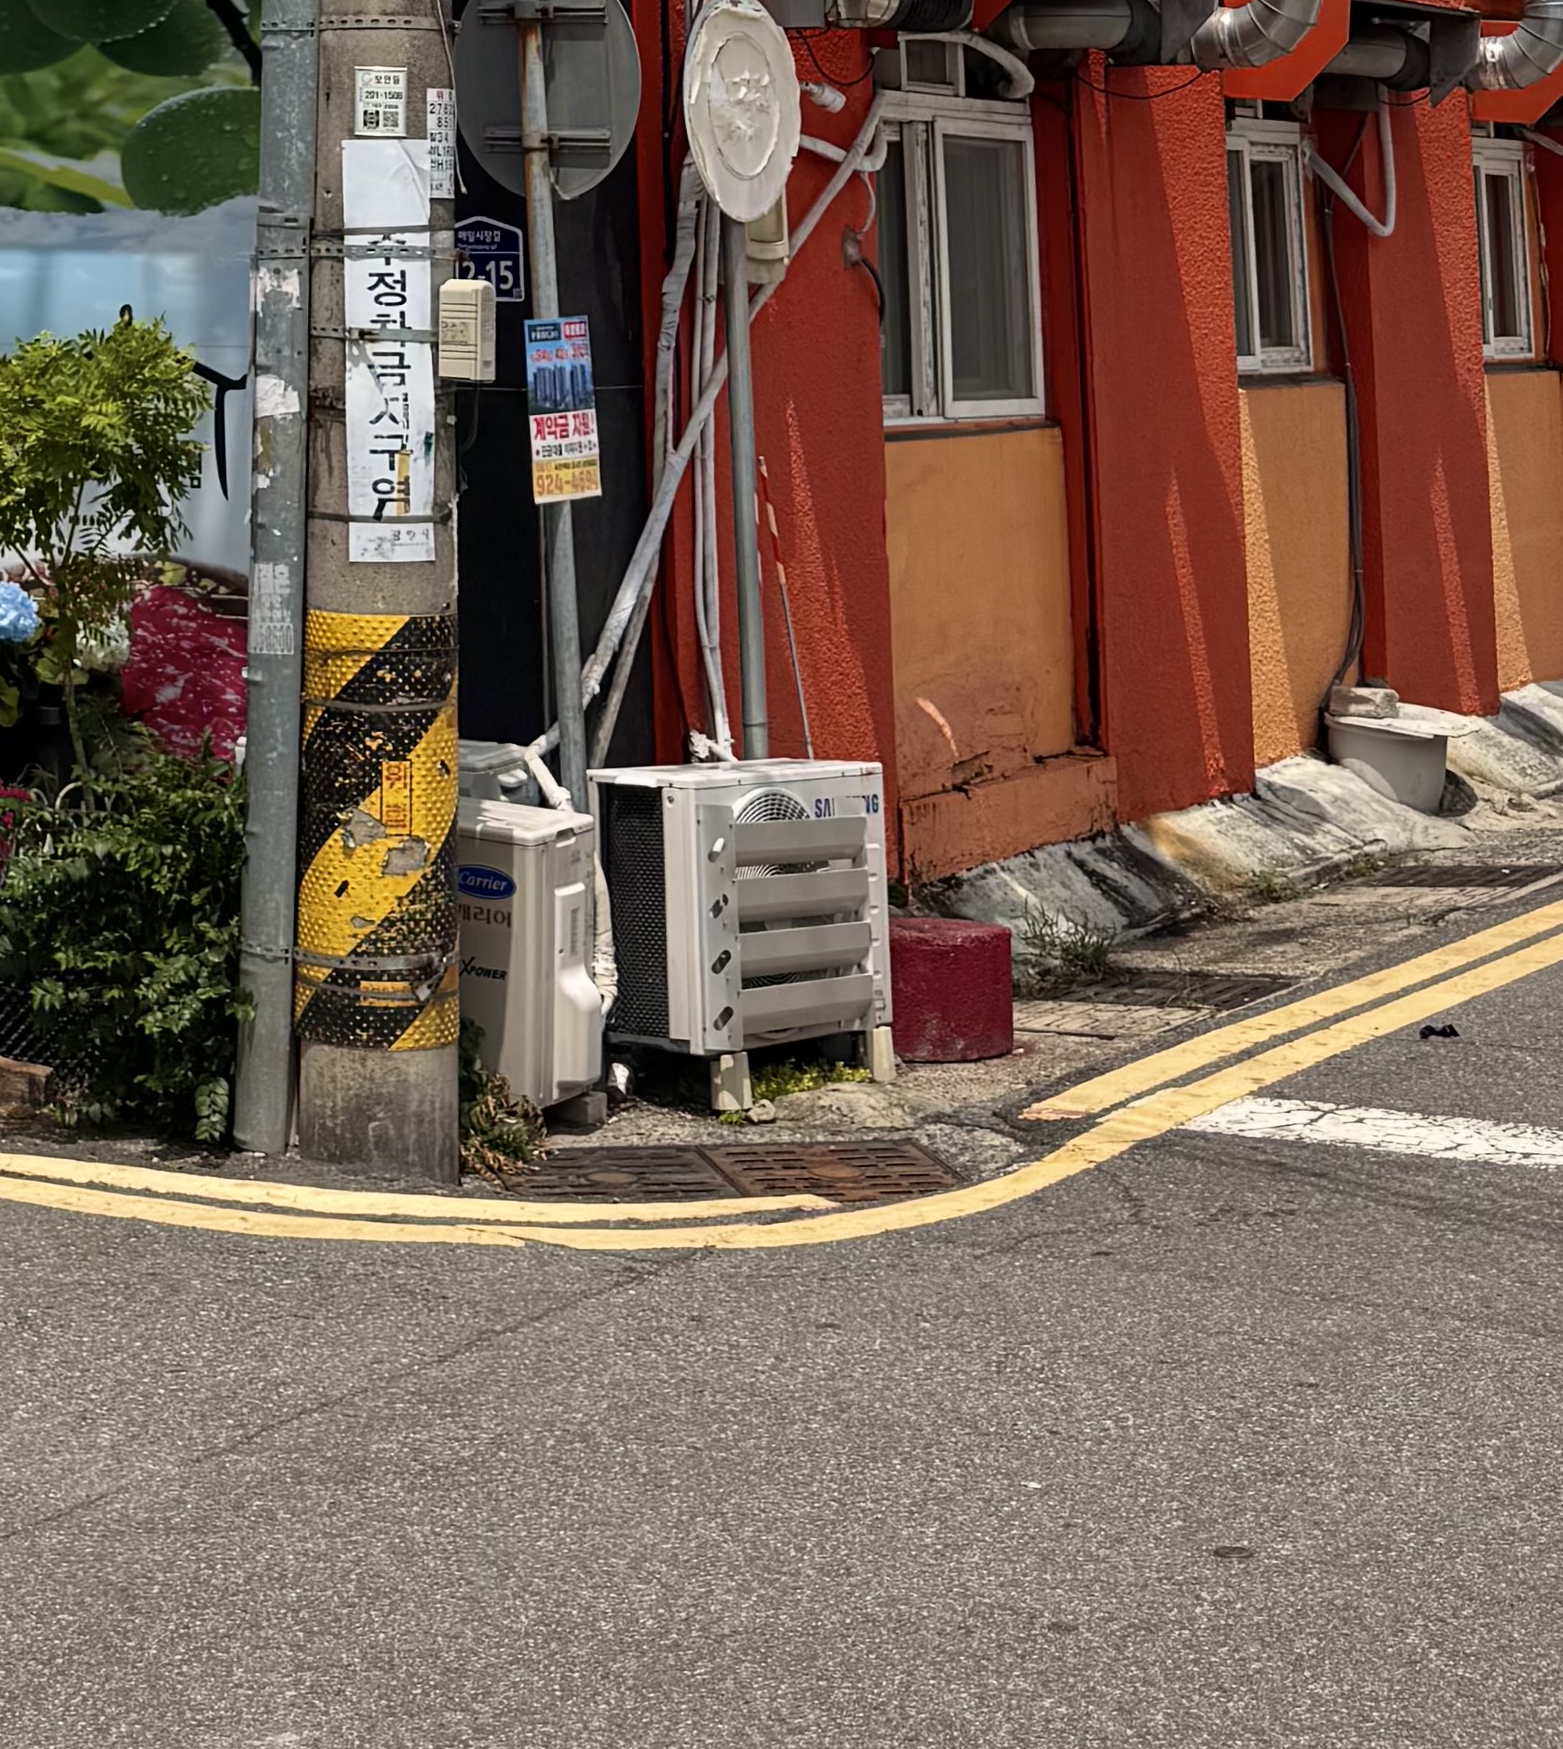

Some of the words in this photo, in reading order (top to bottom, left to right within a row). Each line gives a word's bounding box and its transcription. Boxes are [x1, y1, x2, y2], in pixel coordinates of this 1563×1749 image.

[533, 413, 569, 440] 계약금
[814, 793, 879, 819] SANG
[458, 870, 508, 892] Carrier
